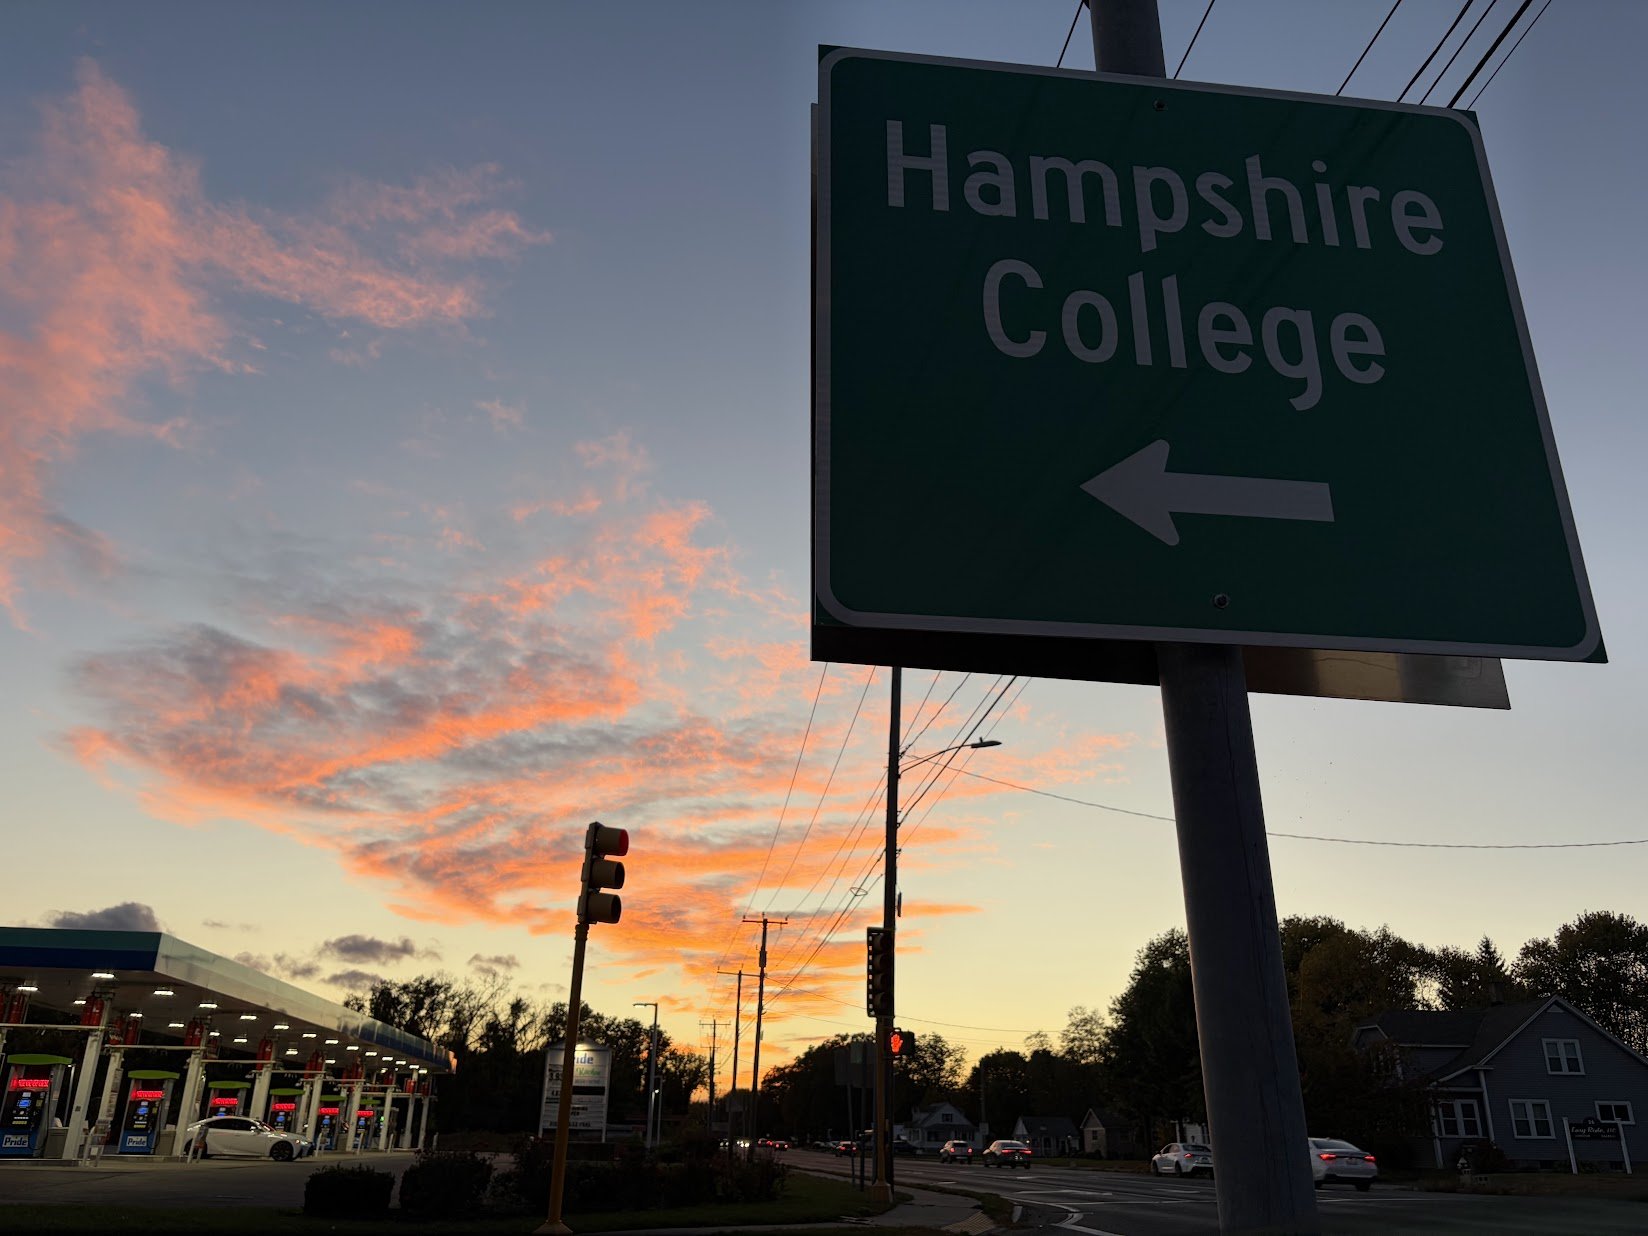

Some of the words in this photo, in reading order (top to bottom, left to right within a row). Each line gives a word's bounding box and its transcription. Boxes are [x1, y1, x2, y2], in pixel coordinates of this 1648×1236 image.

[886, 119, 1445, 256] Hampshire
[982, 259, 1387, 412] College
[4, 1136, 28, 1146] Pride
[127, 1137, 146, 1146] Pride
